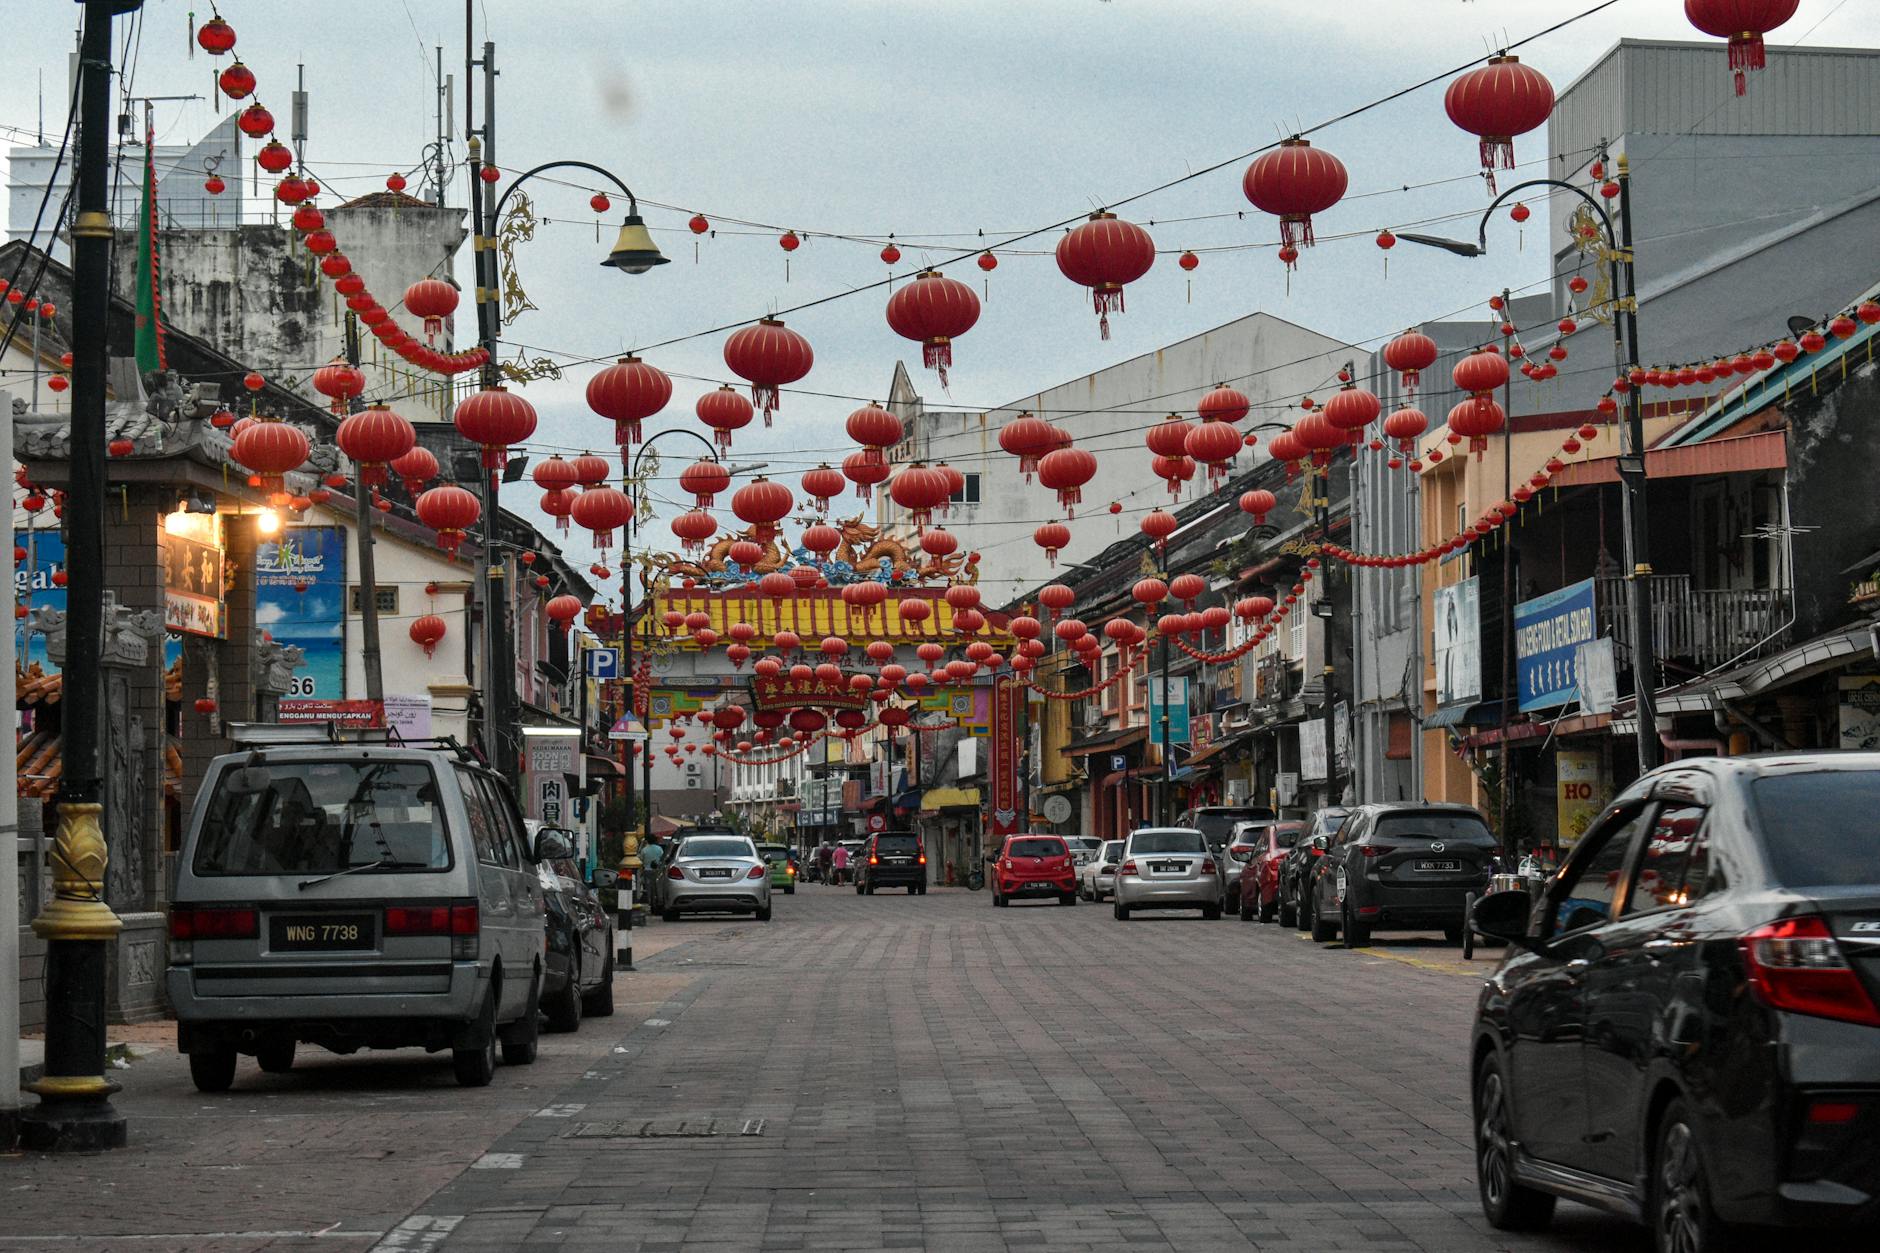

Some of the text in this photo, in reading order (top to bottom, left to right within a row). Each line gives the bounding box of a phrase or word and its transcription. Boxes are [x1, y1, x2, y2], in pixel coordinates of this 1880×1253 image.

[1538, 619, 1551, 654] FOOD
[1580, 607, 1592, 641] BHD
[593, 650, 613, 676] P
[289, 677, 315, 696] 66
[532, 751, 559, 760] SOON
[1113, 757, 1123, 769] P
[532, 760, 559, 770] KEE
[1564, 783, 1592, 800] HO
[1437, 861, 1454, 869] 7733
[286, 925, 358, 941] WNG 7738
